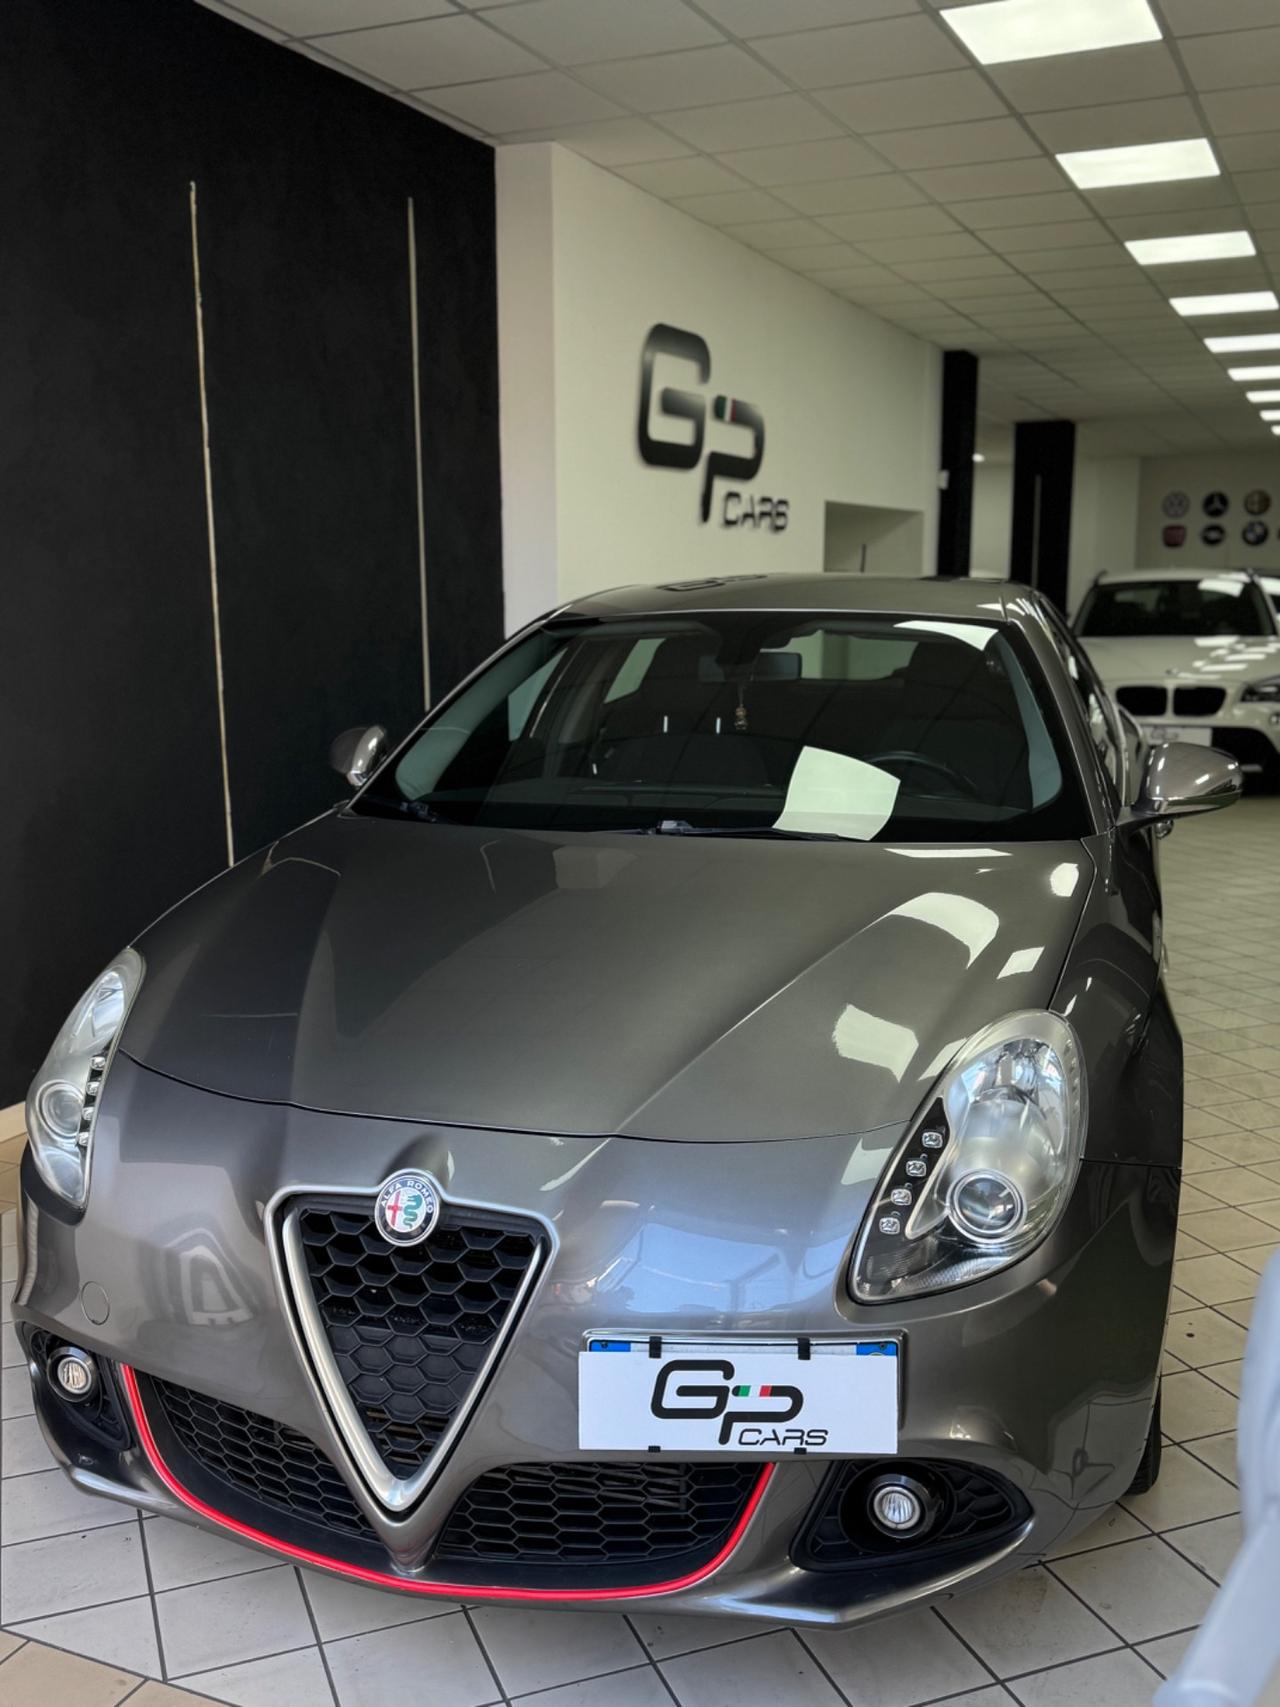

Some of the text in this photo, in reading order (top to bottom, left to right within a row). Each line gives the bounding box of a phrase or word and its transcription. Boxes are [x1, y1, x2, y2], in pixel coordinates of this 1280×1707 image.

[637, 323, 765, 523] GP
[722, 491, 789, 532] CARS
[381, 1180, 434, 1213] ALFA ROMEO
[651, 1359, 803, 1445] GP
[738, 1428, 829, 1446] CARS
